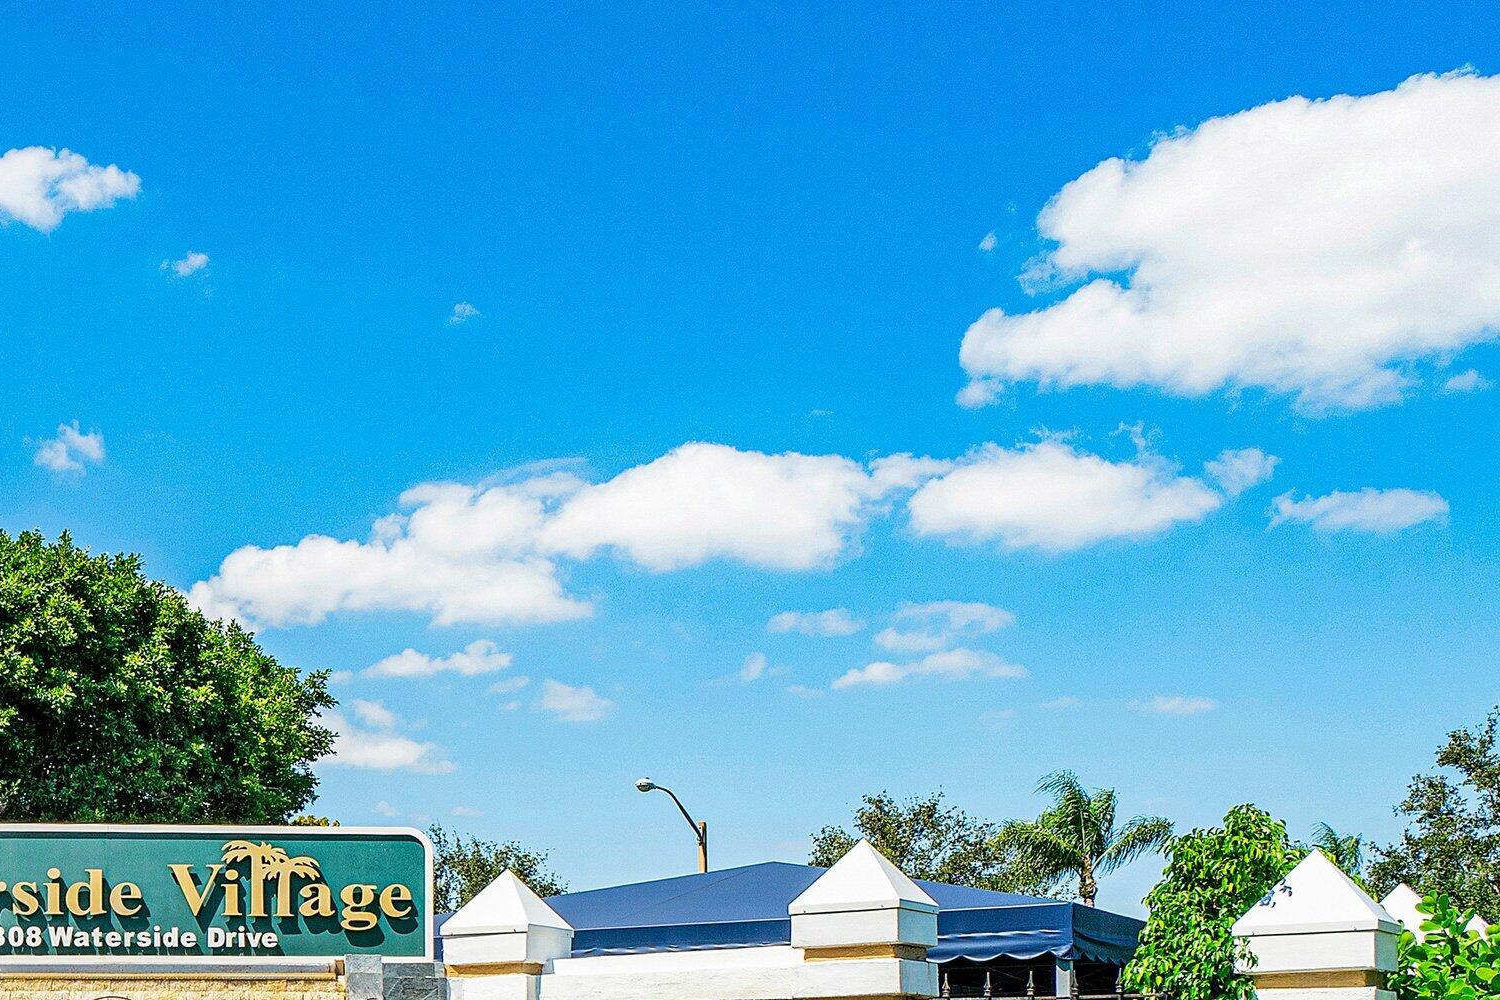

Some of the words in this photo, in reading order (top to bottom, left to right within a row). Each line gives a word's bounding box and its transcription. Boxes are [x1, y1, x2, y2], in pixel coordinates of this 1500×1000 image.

[166, 840, 413, 932] Village
[48, 926, 197, 948] Waterside
[207, 926, 279, 948] Drive
